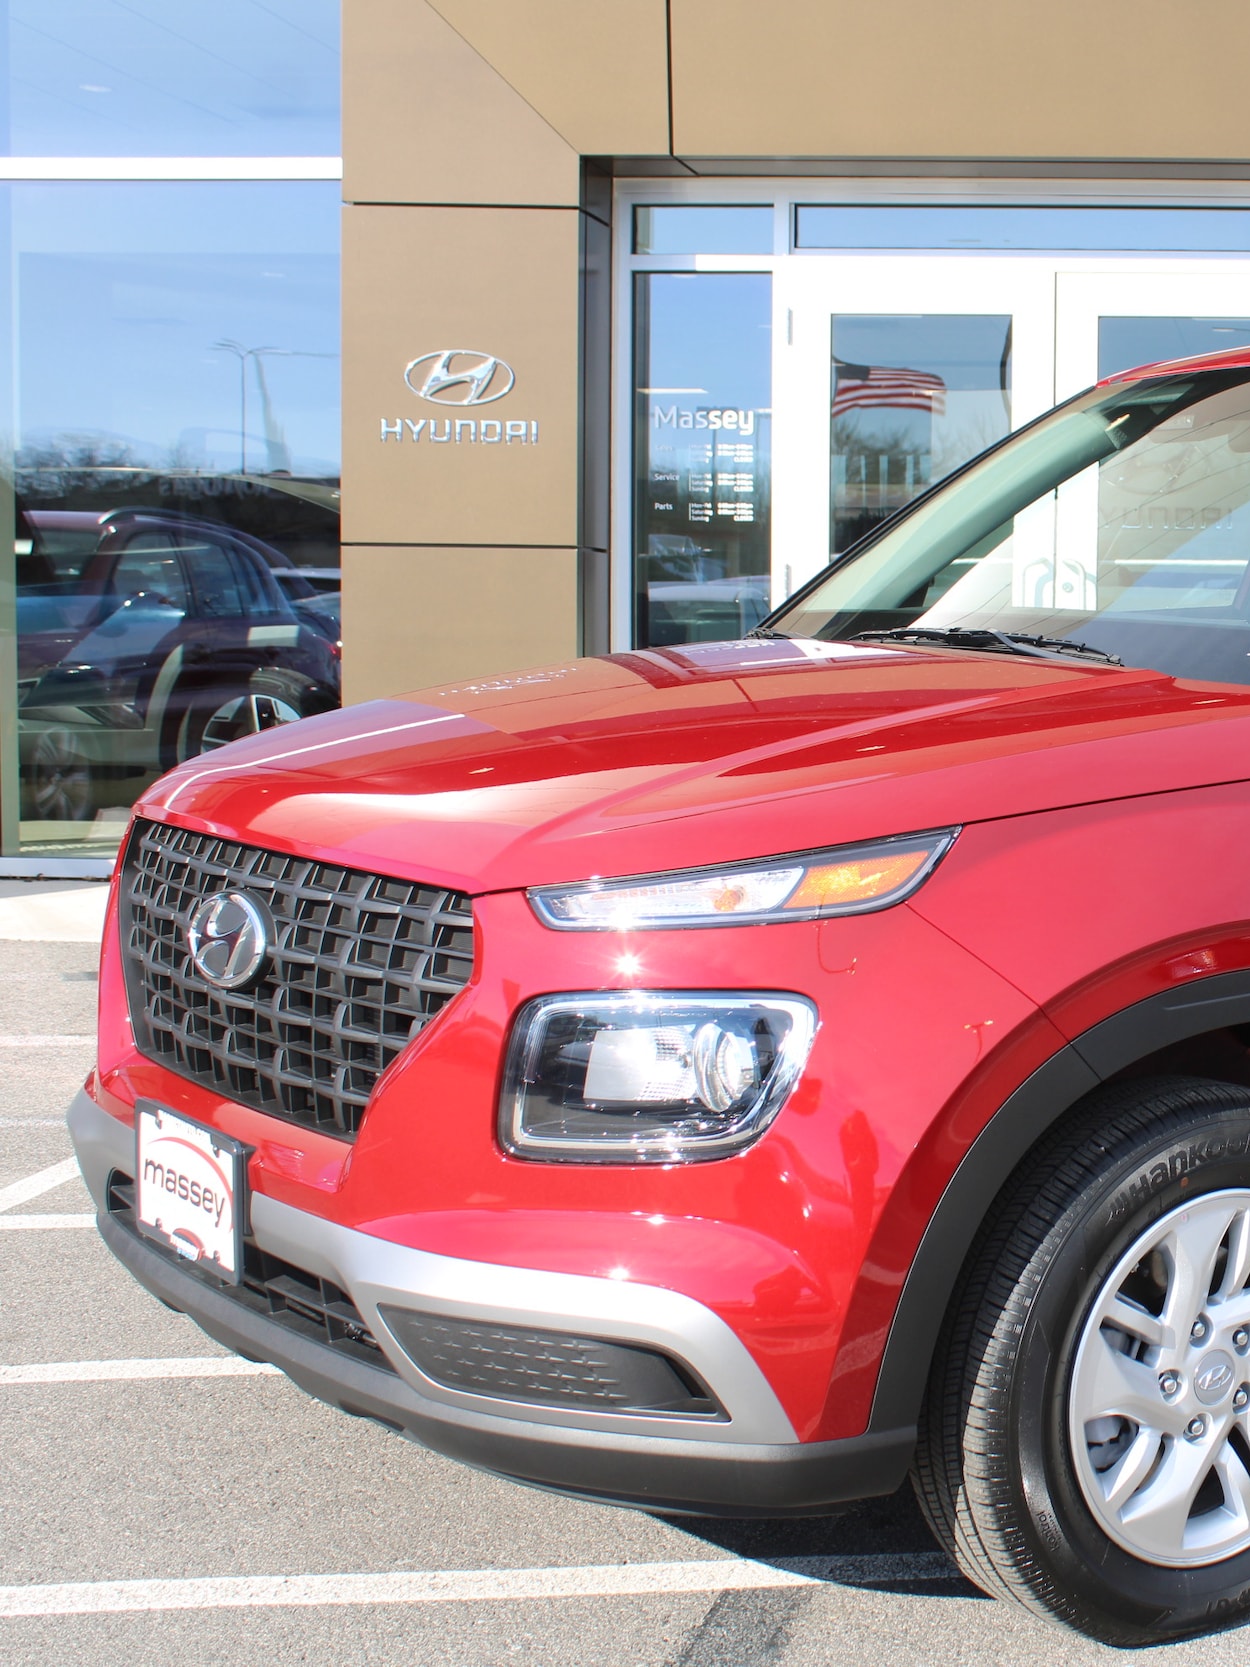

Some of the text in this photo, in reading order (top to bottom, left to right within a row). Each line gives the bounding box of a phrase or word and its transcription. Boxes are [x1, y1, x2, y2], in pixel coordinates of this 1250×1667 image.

[380, 418, 539, 445] HYUNDAI
[654, 405, 754, 436] Massey
[653, 473, 680, 481] Service
[654, 502, 674, 510] Parts
[143, 1157, 225, 1228] massey
